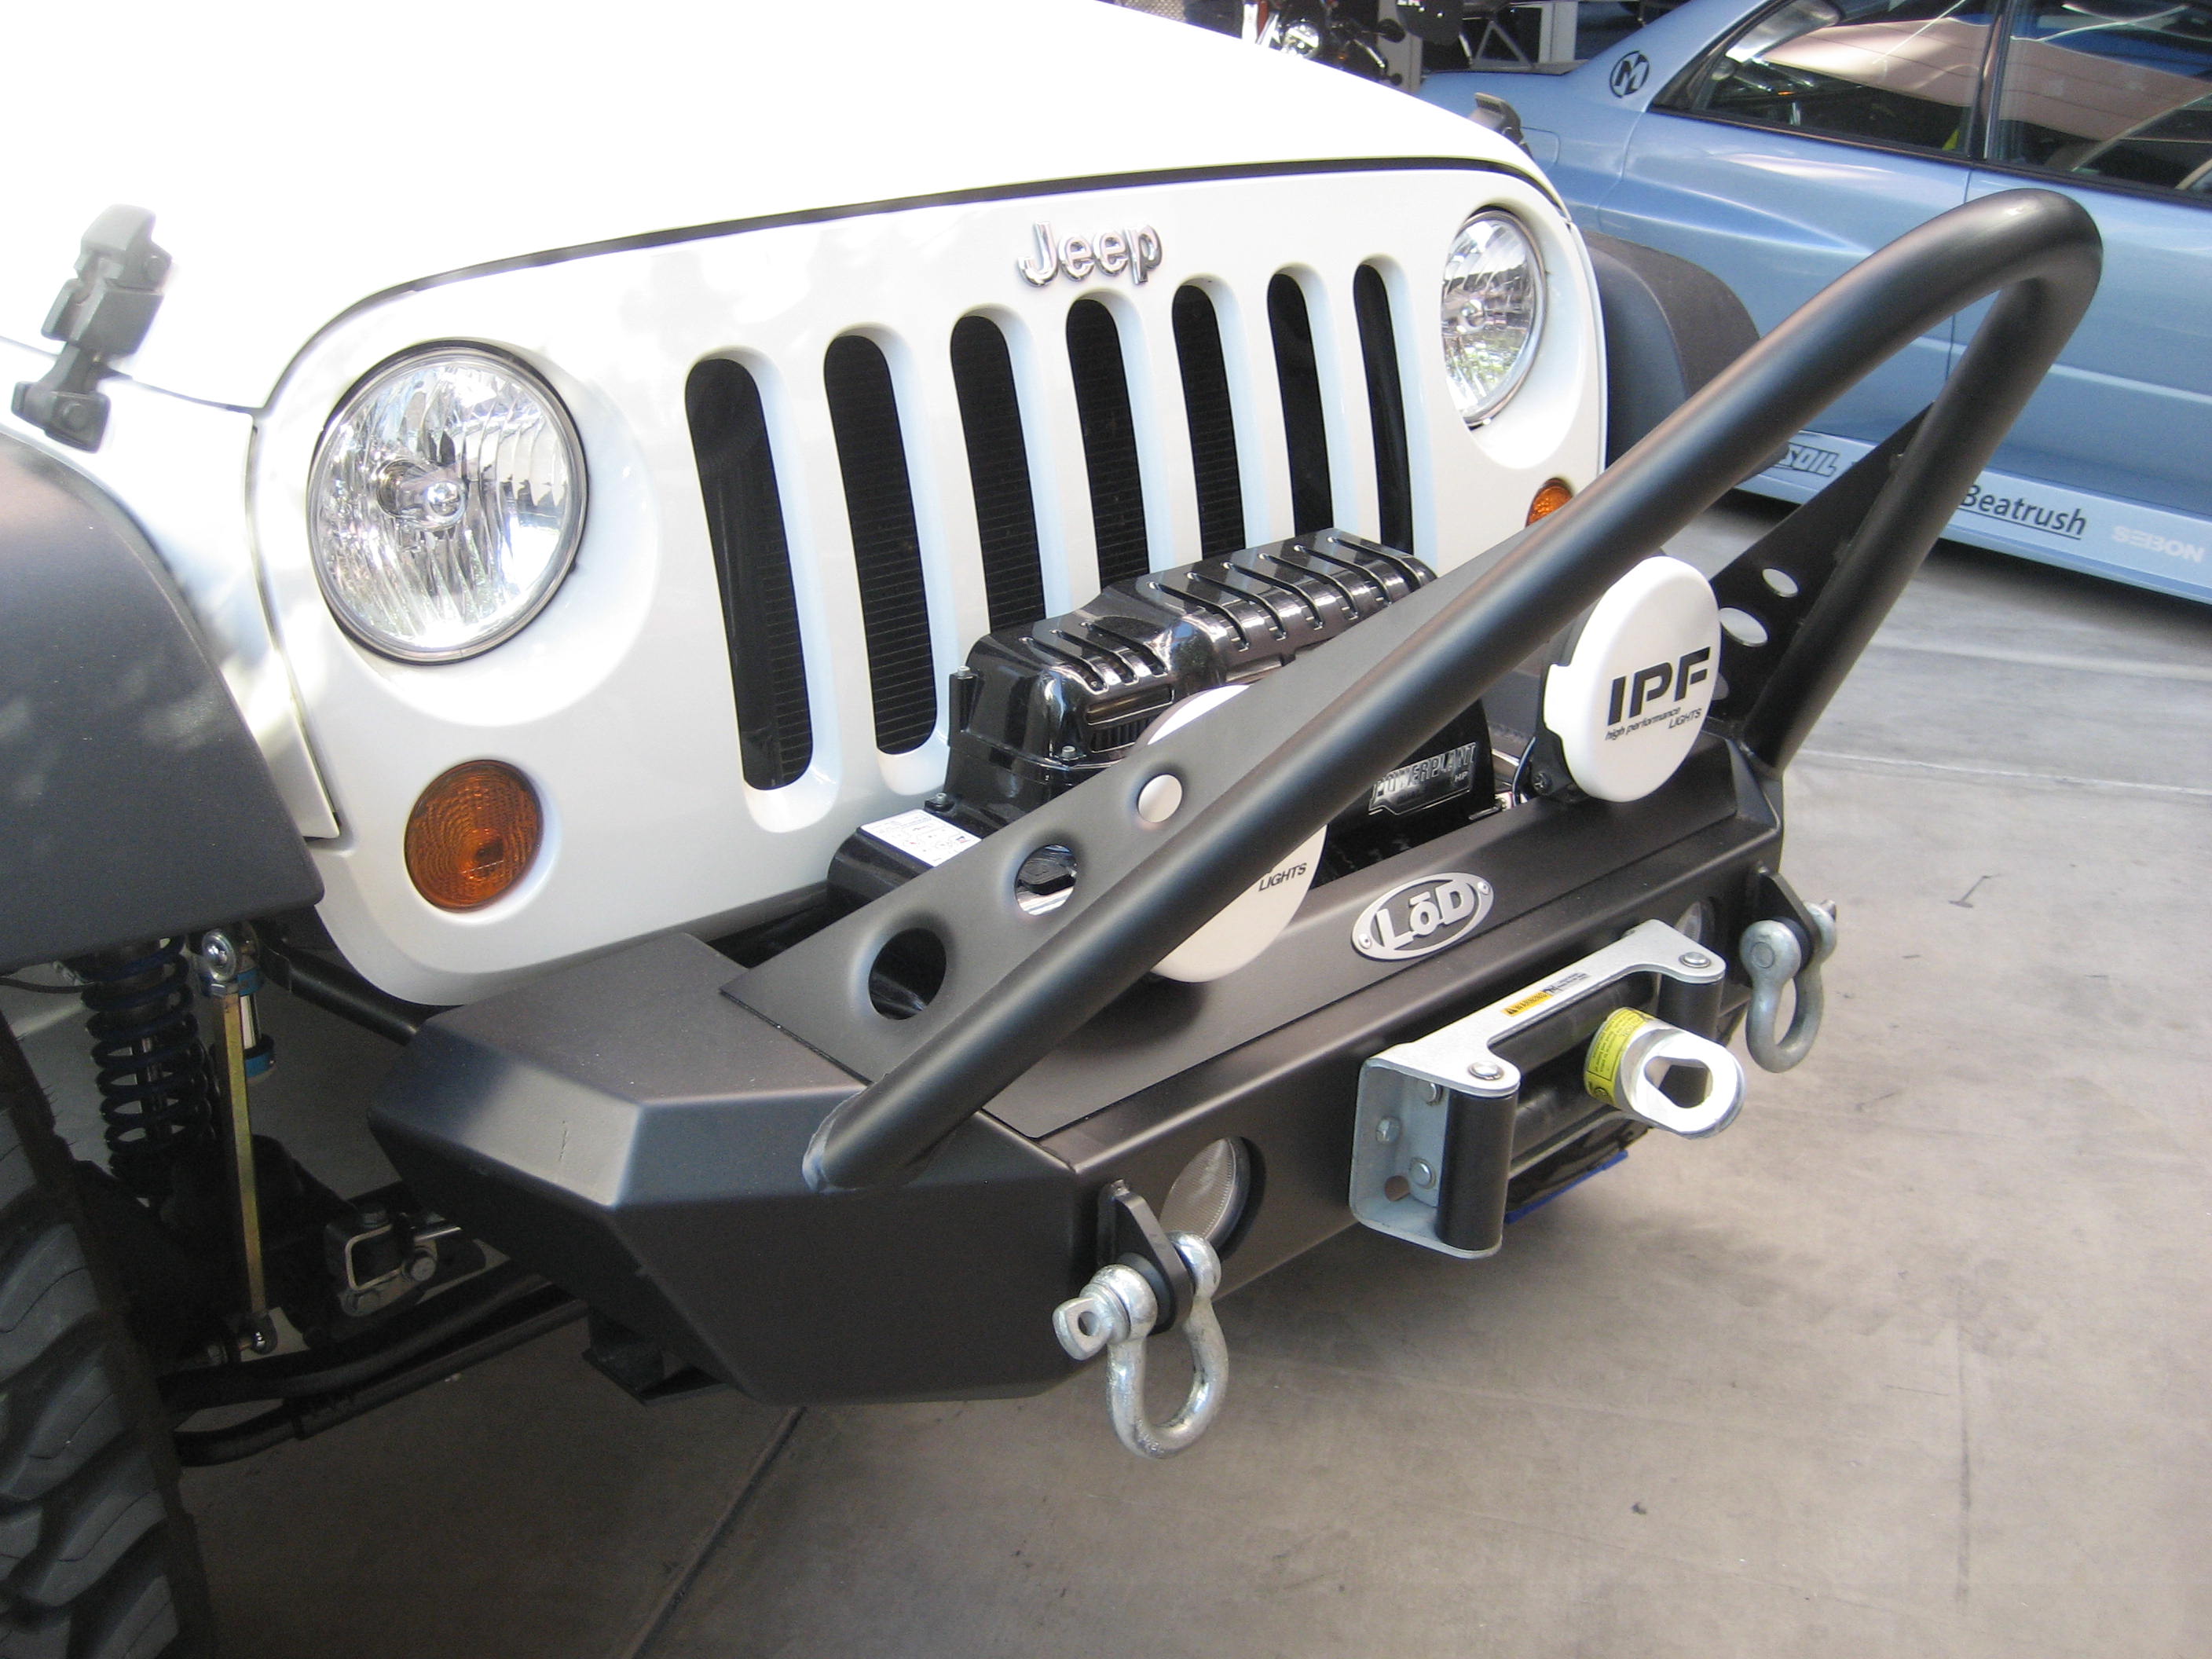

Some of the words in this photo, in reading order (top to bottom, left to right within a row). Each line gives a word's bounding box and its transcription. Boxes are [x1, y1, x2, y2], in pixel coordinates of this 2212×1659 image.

[1017, 220, 1163, 287] Jeep
[1961, 485, 2086, 535] Beatrush
[2111, 526, 2205, 563] SEBON
[1607, 646, 1710, 726] IPF
[1668, 708, 1702, 729] LIGHTS
[1258, 862, 1307, 892] LIGHTS
